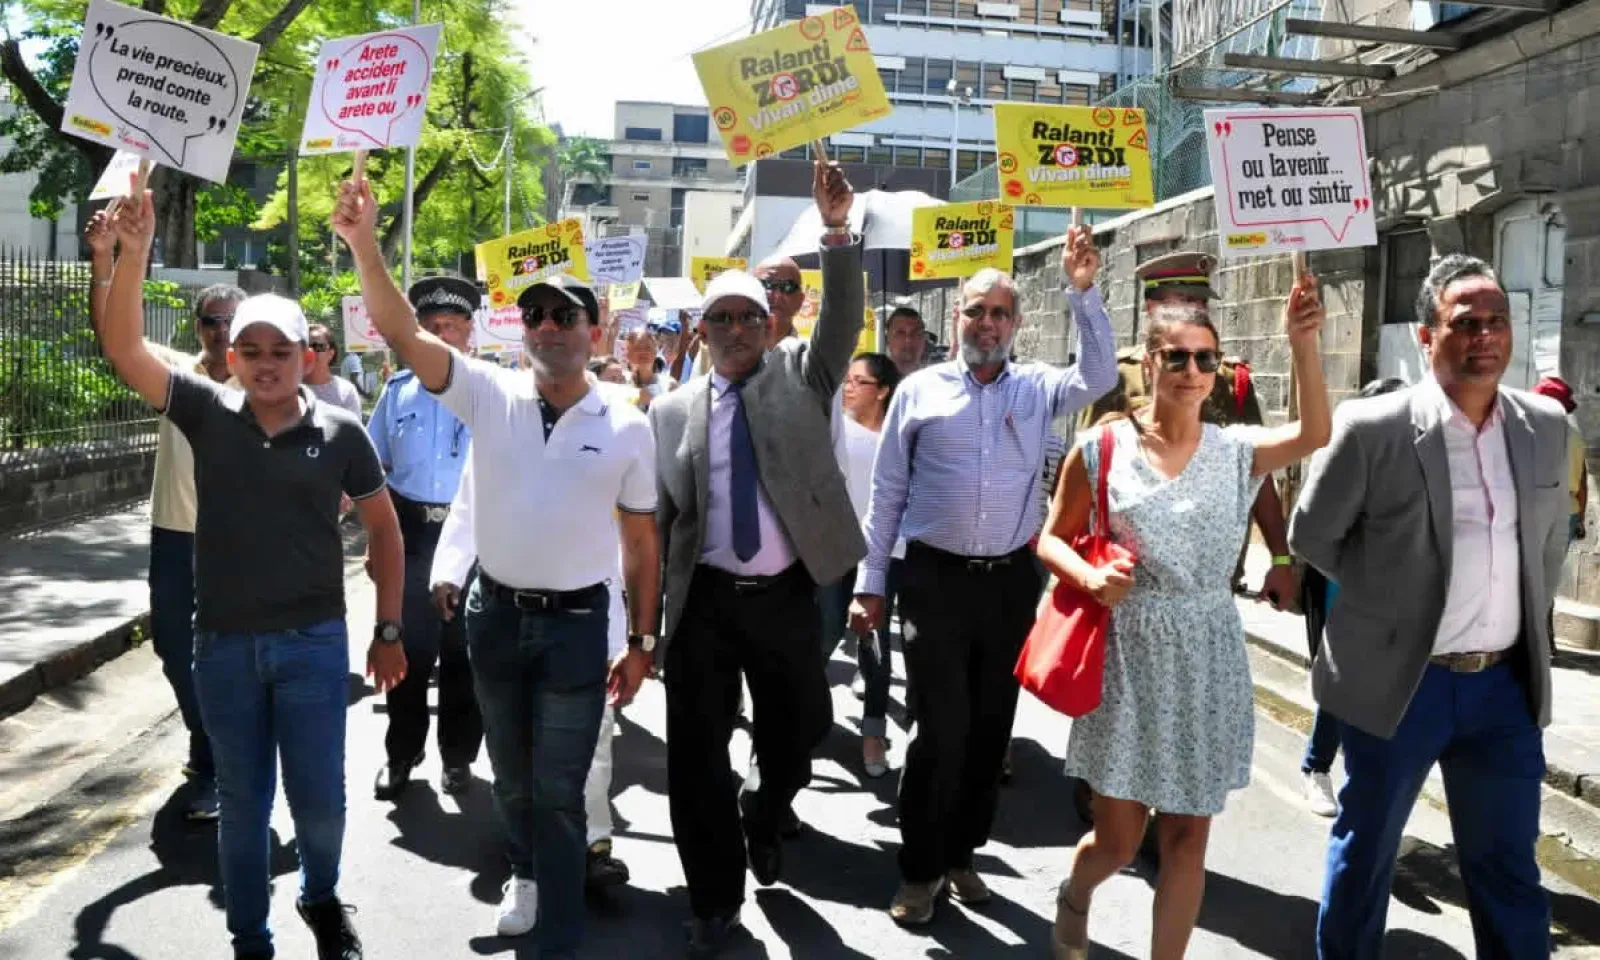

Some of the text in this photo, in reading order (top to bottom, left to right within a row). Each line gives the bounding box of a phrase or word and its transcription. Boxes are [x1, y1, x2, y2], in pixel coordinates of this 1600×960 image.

[109, 38, 129, 54] La
[131, 44, 154, 64] vie
[358, 44, 398, 61] Arete
[740, 39, 831, 80] Ralanti
[344, 60, 407, 82] accident
[117, 67, 211, 106] prend conte
[346, 79, 398, 100] avant li
[127, 90, 141, 107] la
[339, 101, 397, 119] arete ou
[748, 101, 807, 131] Vivan
[810, 75, 860, 106] dime
[1033, 121, 1115, 147] Ralanti
[1262, 123, 1317, 147] Pense
[1028, 162, 1131, 182] Vivan dime
[1242, 150, 1343, 178] ou lavenir...
[1238, 180, 1353, 209] met ou sintir
[935, 215, 991, 231] Ralanti
[508, 238, 561, 261] Ralanti
